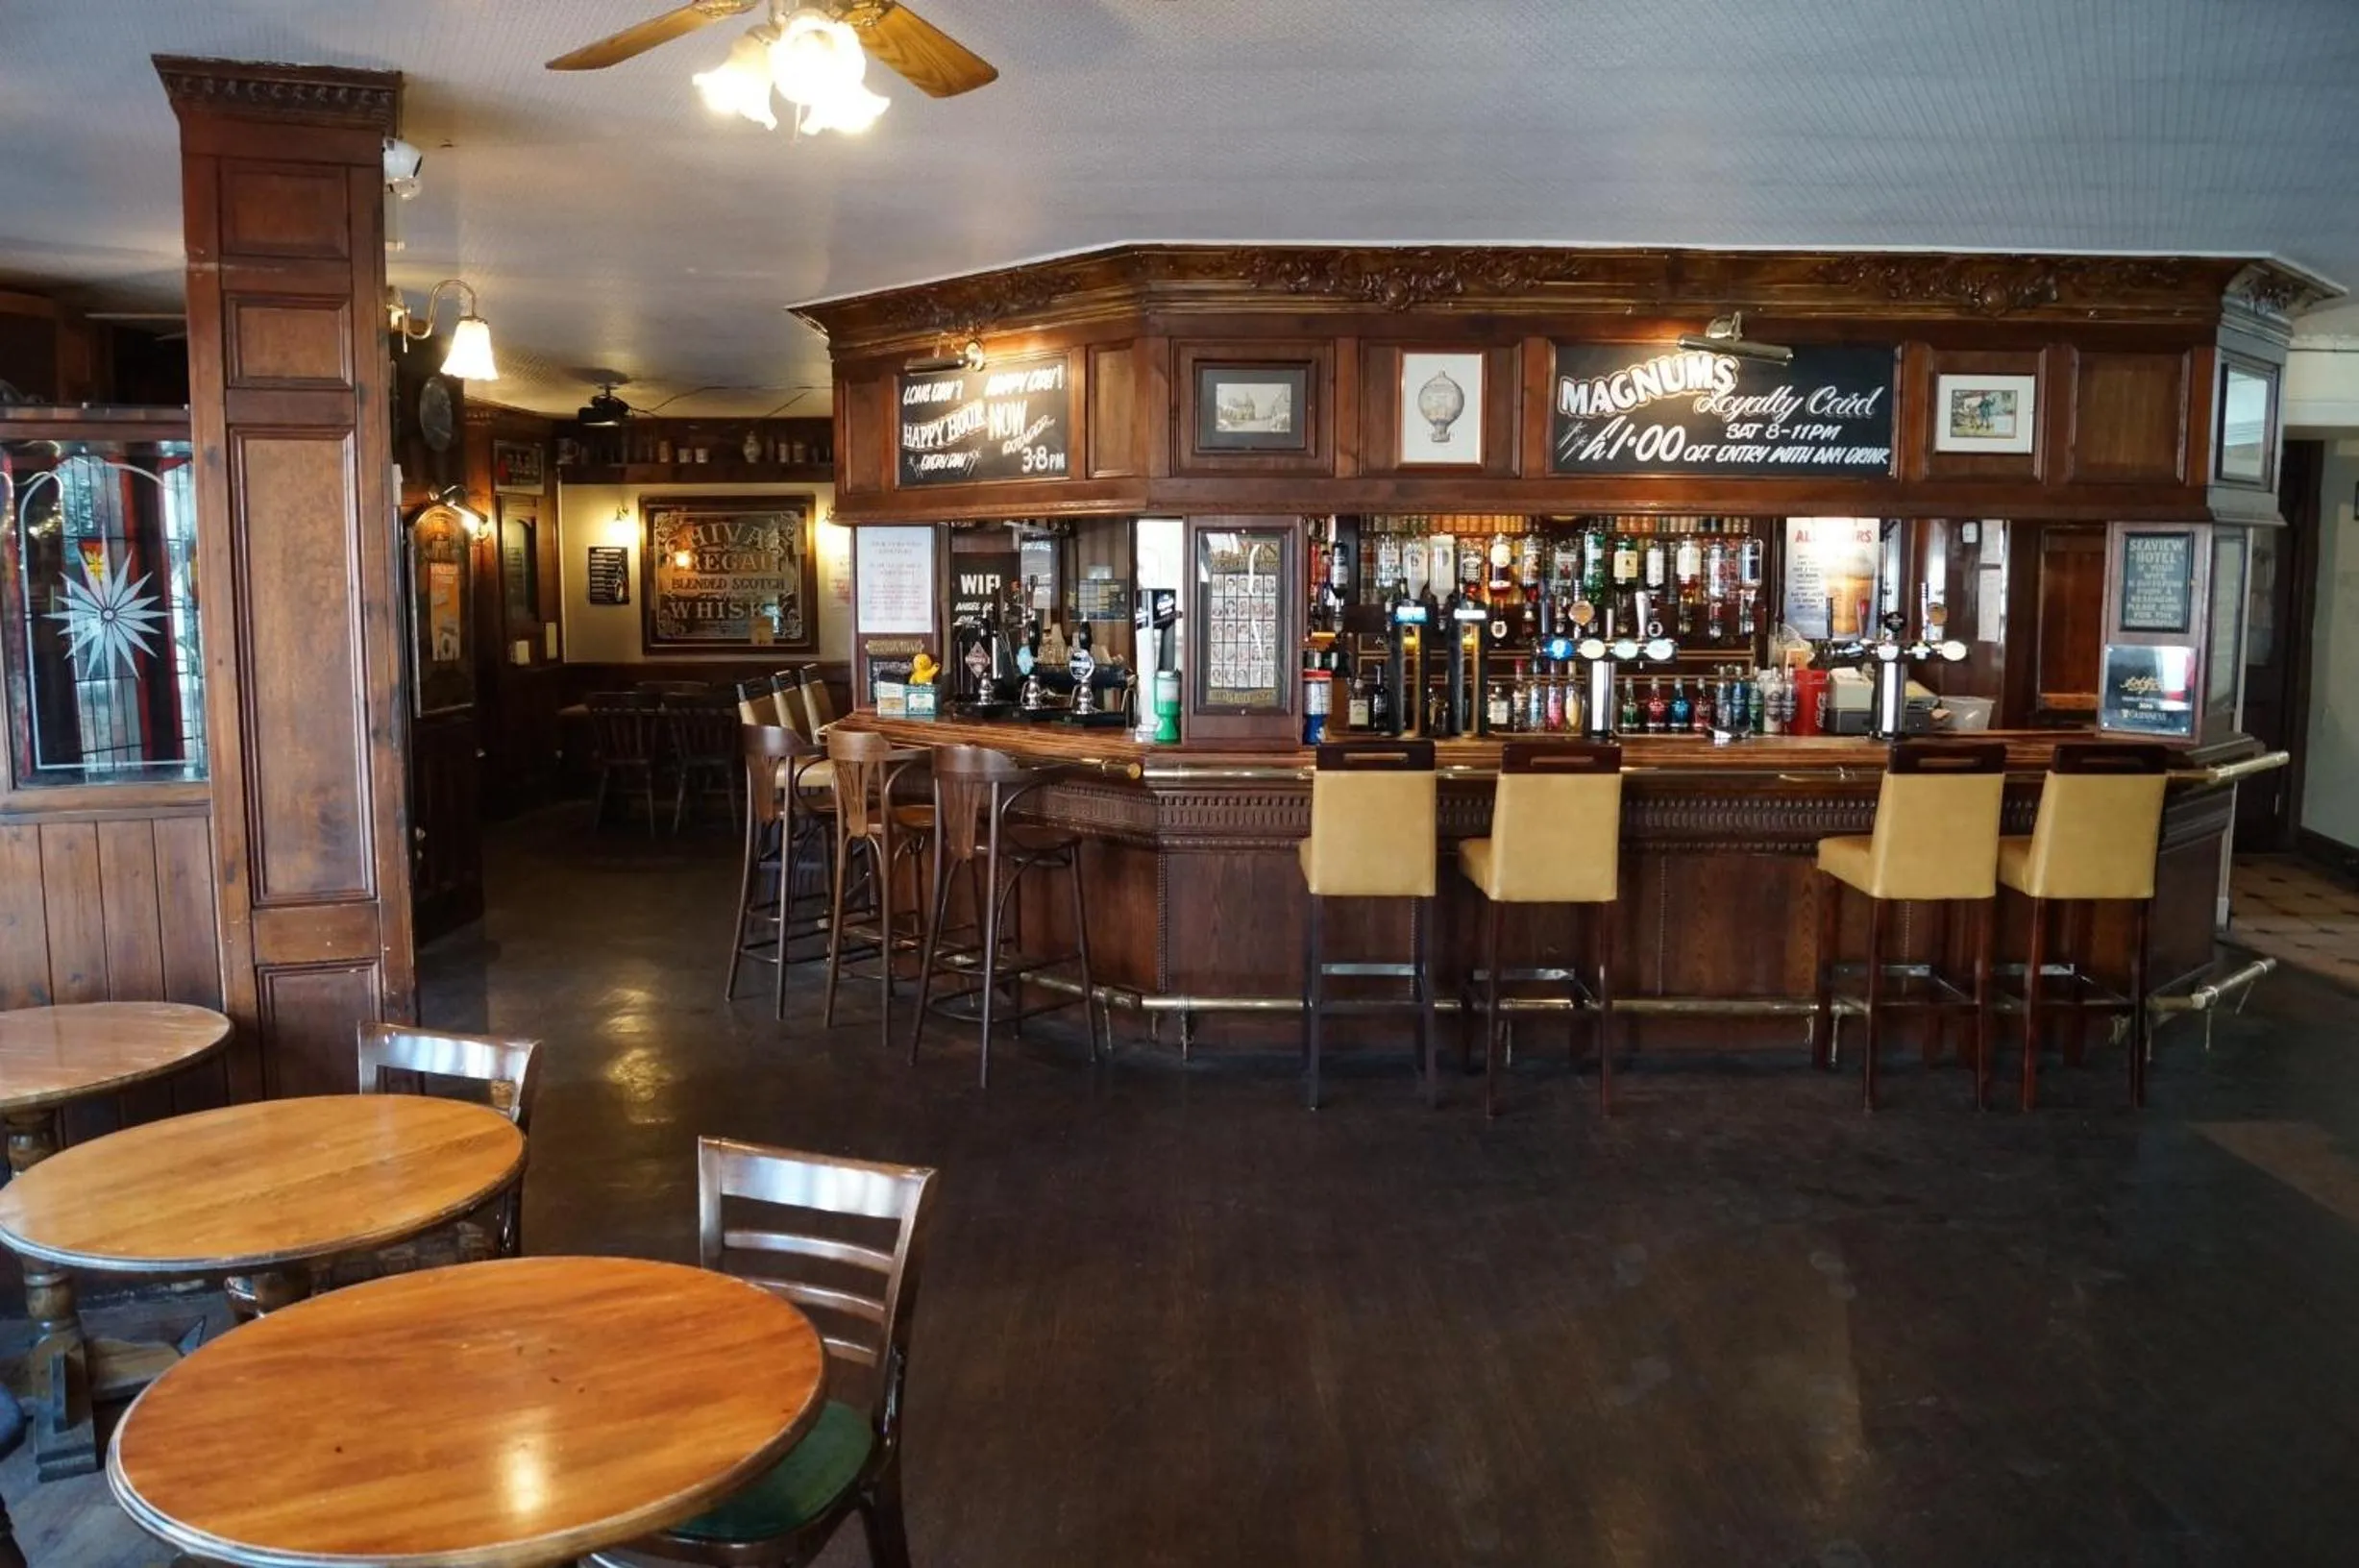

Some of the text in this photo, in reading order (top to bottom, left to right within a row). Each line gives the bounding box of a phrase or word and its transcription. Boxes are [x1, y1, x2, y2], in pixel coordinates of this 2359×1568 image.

[903, 383, 930, 405] LONG
[1559, 353, 1739, 417] MAGNUMS
[1694, 385, 1885, 423] Loyalty Card
[902, 399, 1027, 450] HAPPY HOUR NOW
[1726, 424, 1842, 441] SAT 8-11PM
[1683, 444, 1718, 462] OFF
[1715, 444, 1770, 463] ENTRY
[1768, 445, 1815, 464] WITH
[1812, 446, 1846, 465] ANY
[1844, 448, 1890, 465] DRINK
[2128, 538, 2185, 551] SEAVIEW
[2136, 552, 2176, 564] HOTEL
[672, 577, 785, 590] BLENDED SCOTCH
[961, 574, 1000, 595] WIFI
